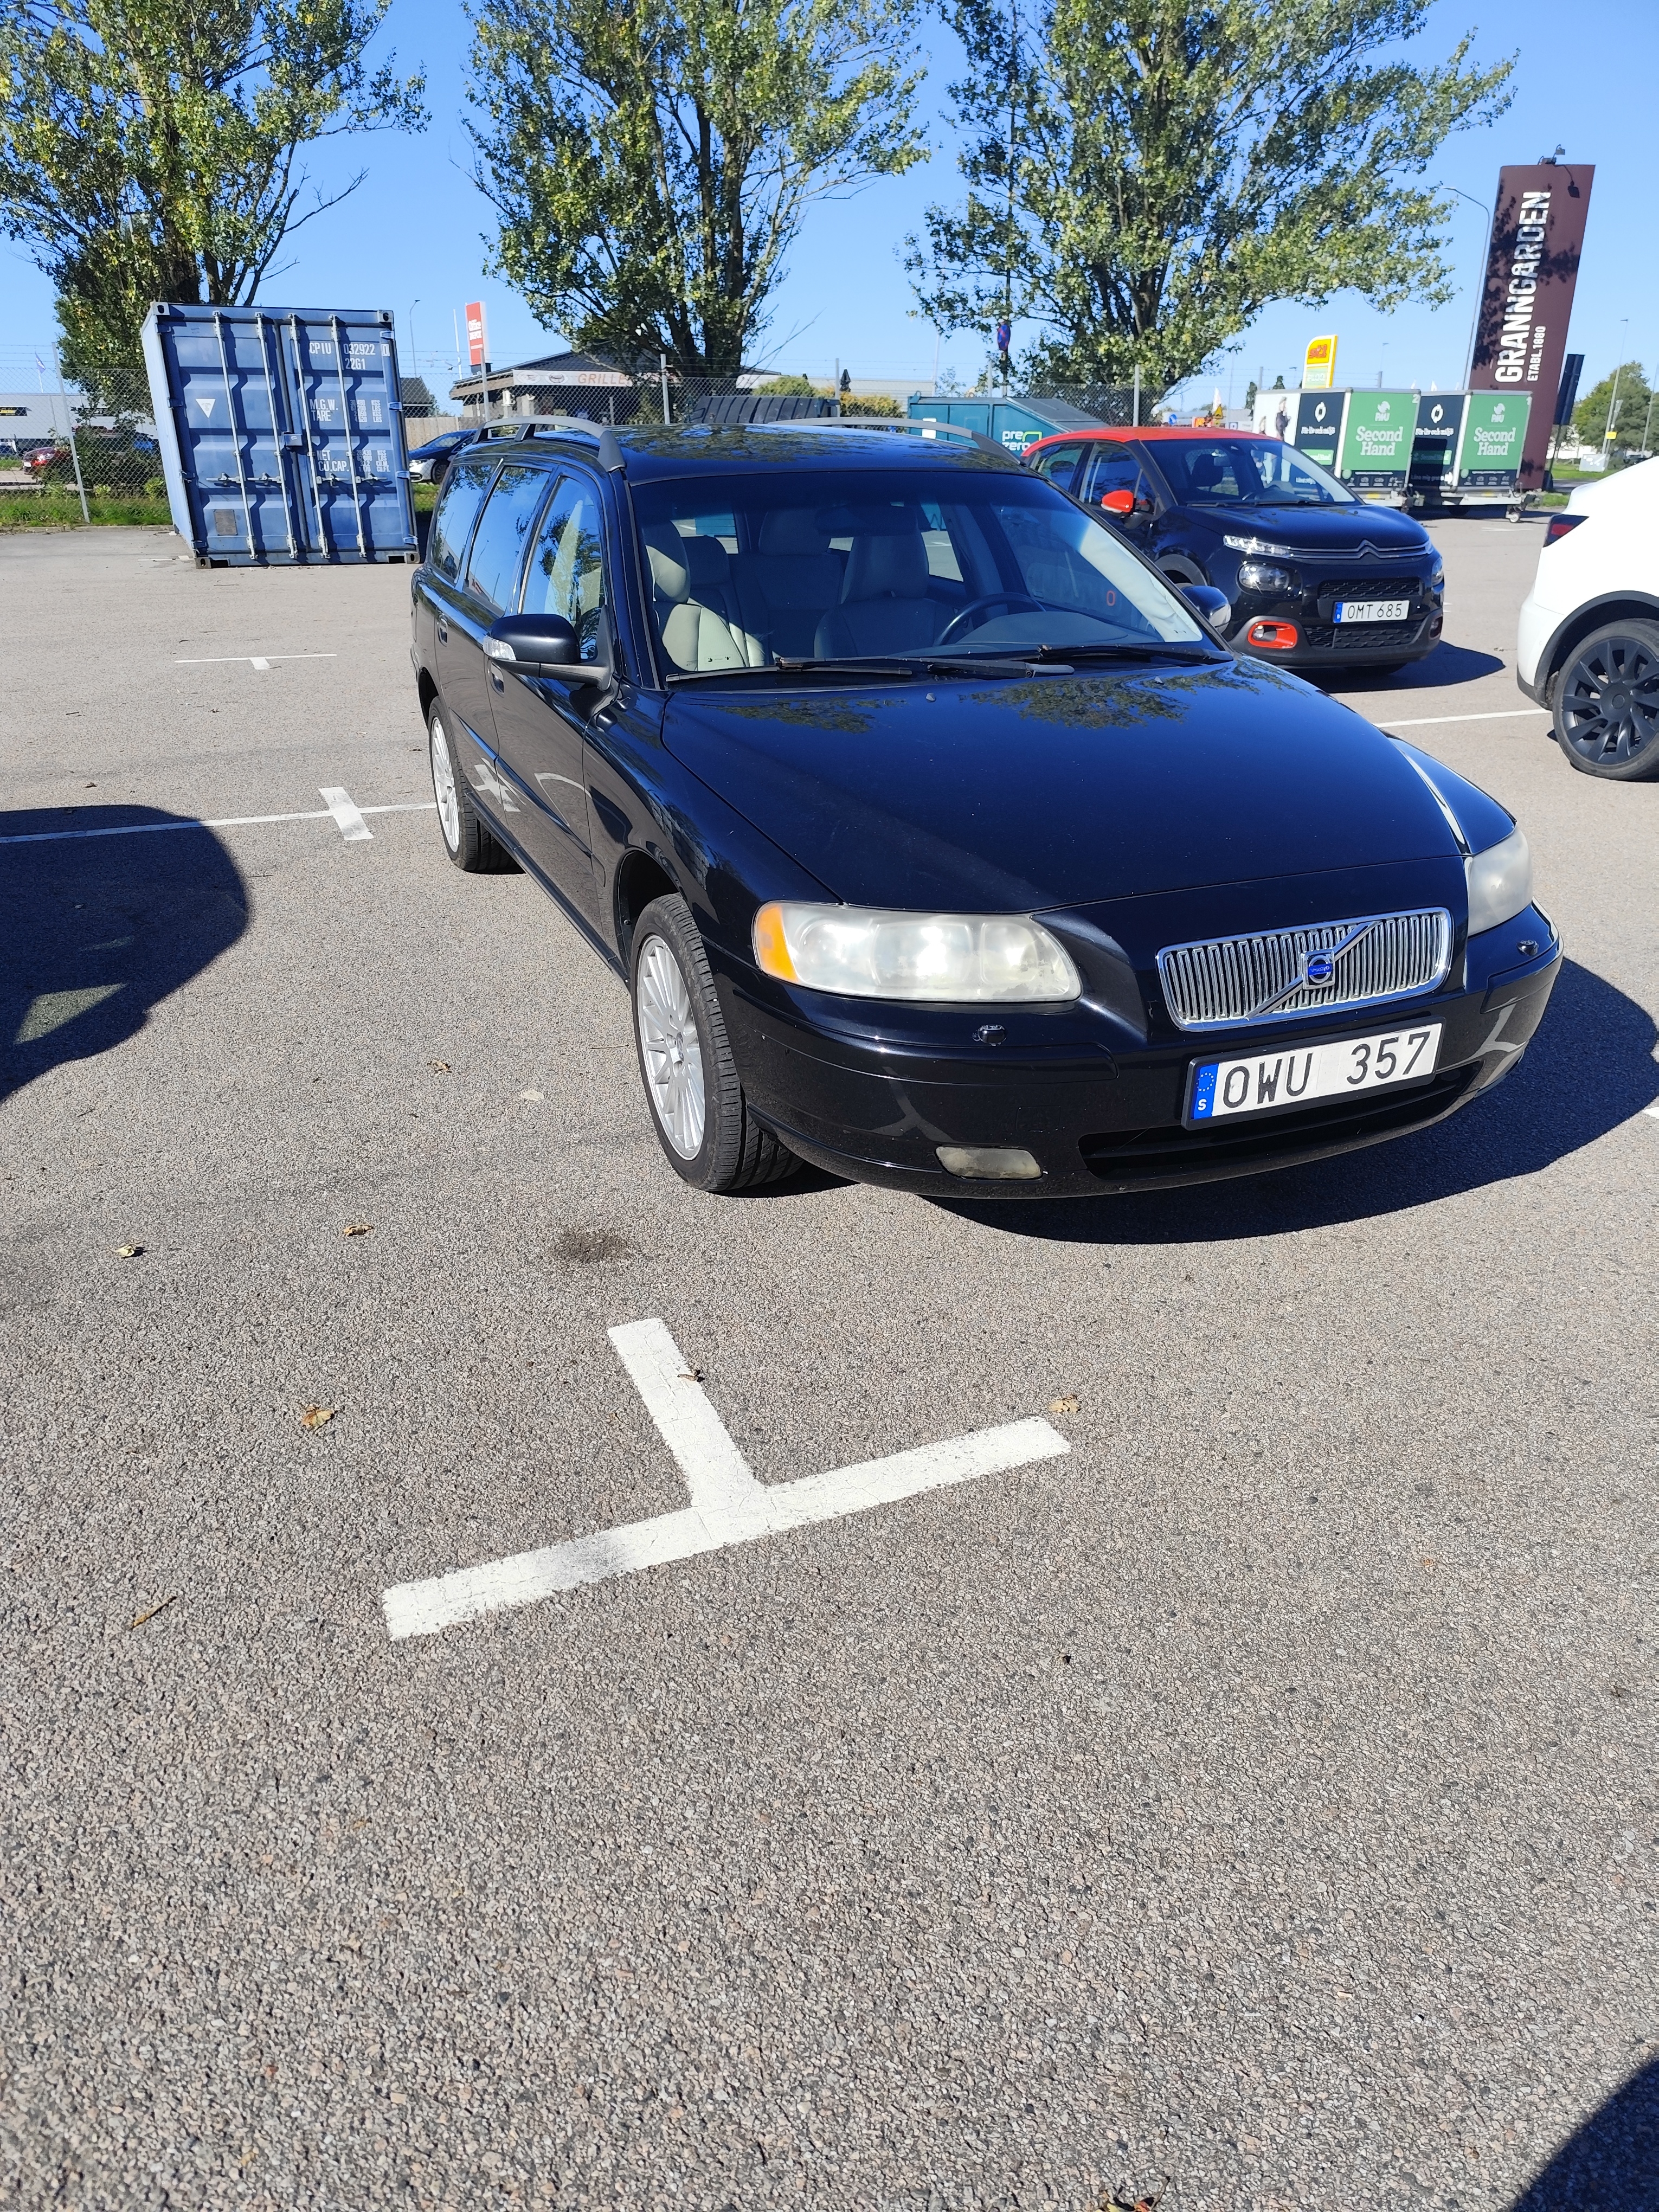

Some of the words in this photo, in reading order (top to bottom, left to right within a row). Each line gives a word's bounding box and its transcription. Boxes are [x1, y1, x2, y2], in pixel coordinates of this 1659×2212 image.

[1495, 191, 1551, 382] GRANNGÅRDEN
[309, 342, 332, 354] CPIU
[343, 343, 376, 355] 032922
[345, 358, 366, 370] 22G1
[309, 399, 338, 410] M.G.W.
[1412, 394, 1419, 403] 2
[311, 410, 332, 421] TARE
[1002, 430, 1024, 441] pre
[1355, 426, 1404, 442] Second
[1473, 427, 1516, 442] Second
[1001, 442, 1031, 451] zero
[1360, 441, 1396, 456] Hand
[1477, 442, 1509, 455] Hand
[316, 450, 331, 461] NET
[318, 461, 349, 472] CU.CAP.
[1347, 604, 1374, 619] OMT
[1377, 603, 1402, 618] 685
[1222, 1052, 1314, 1109] OWU
[1346, 1032, 1431, 1085] 357
[1198, 1098, 1207, 1111] S
